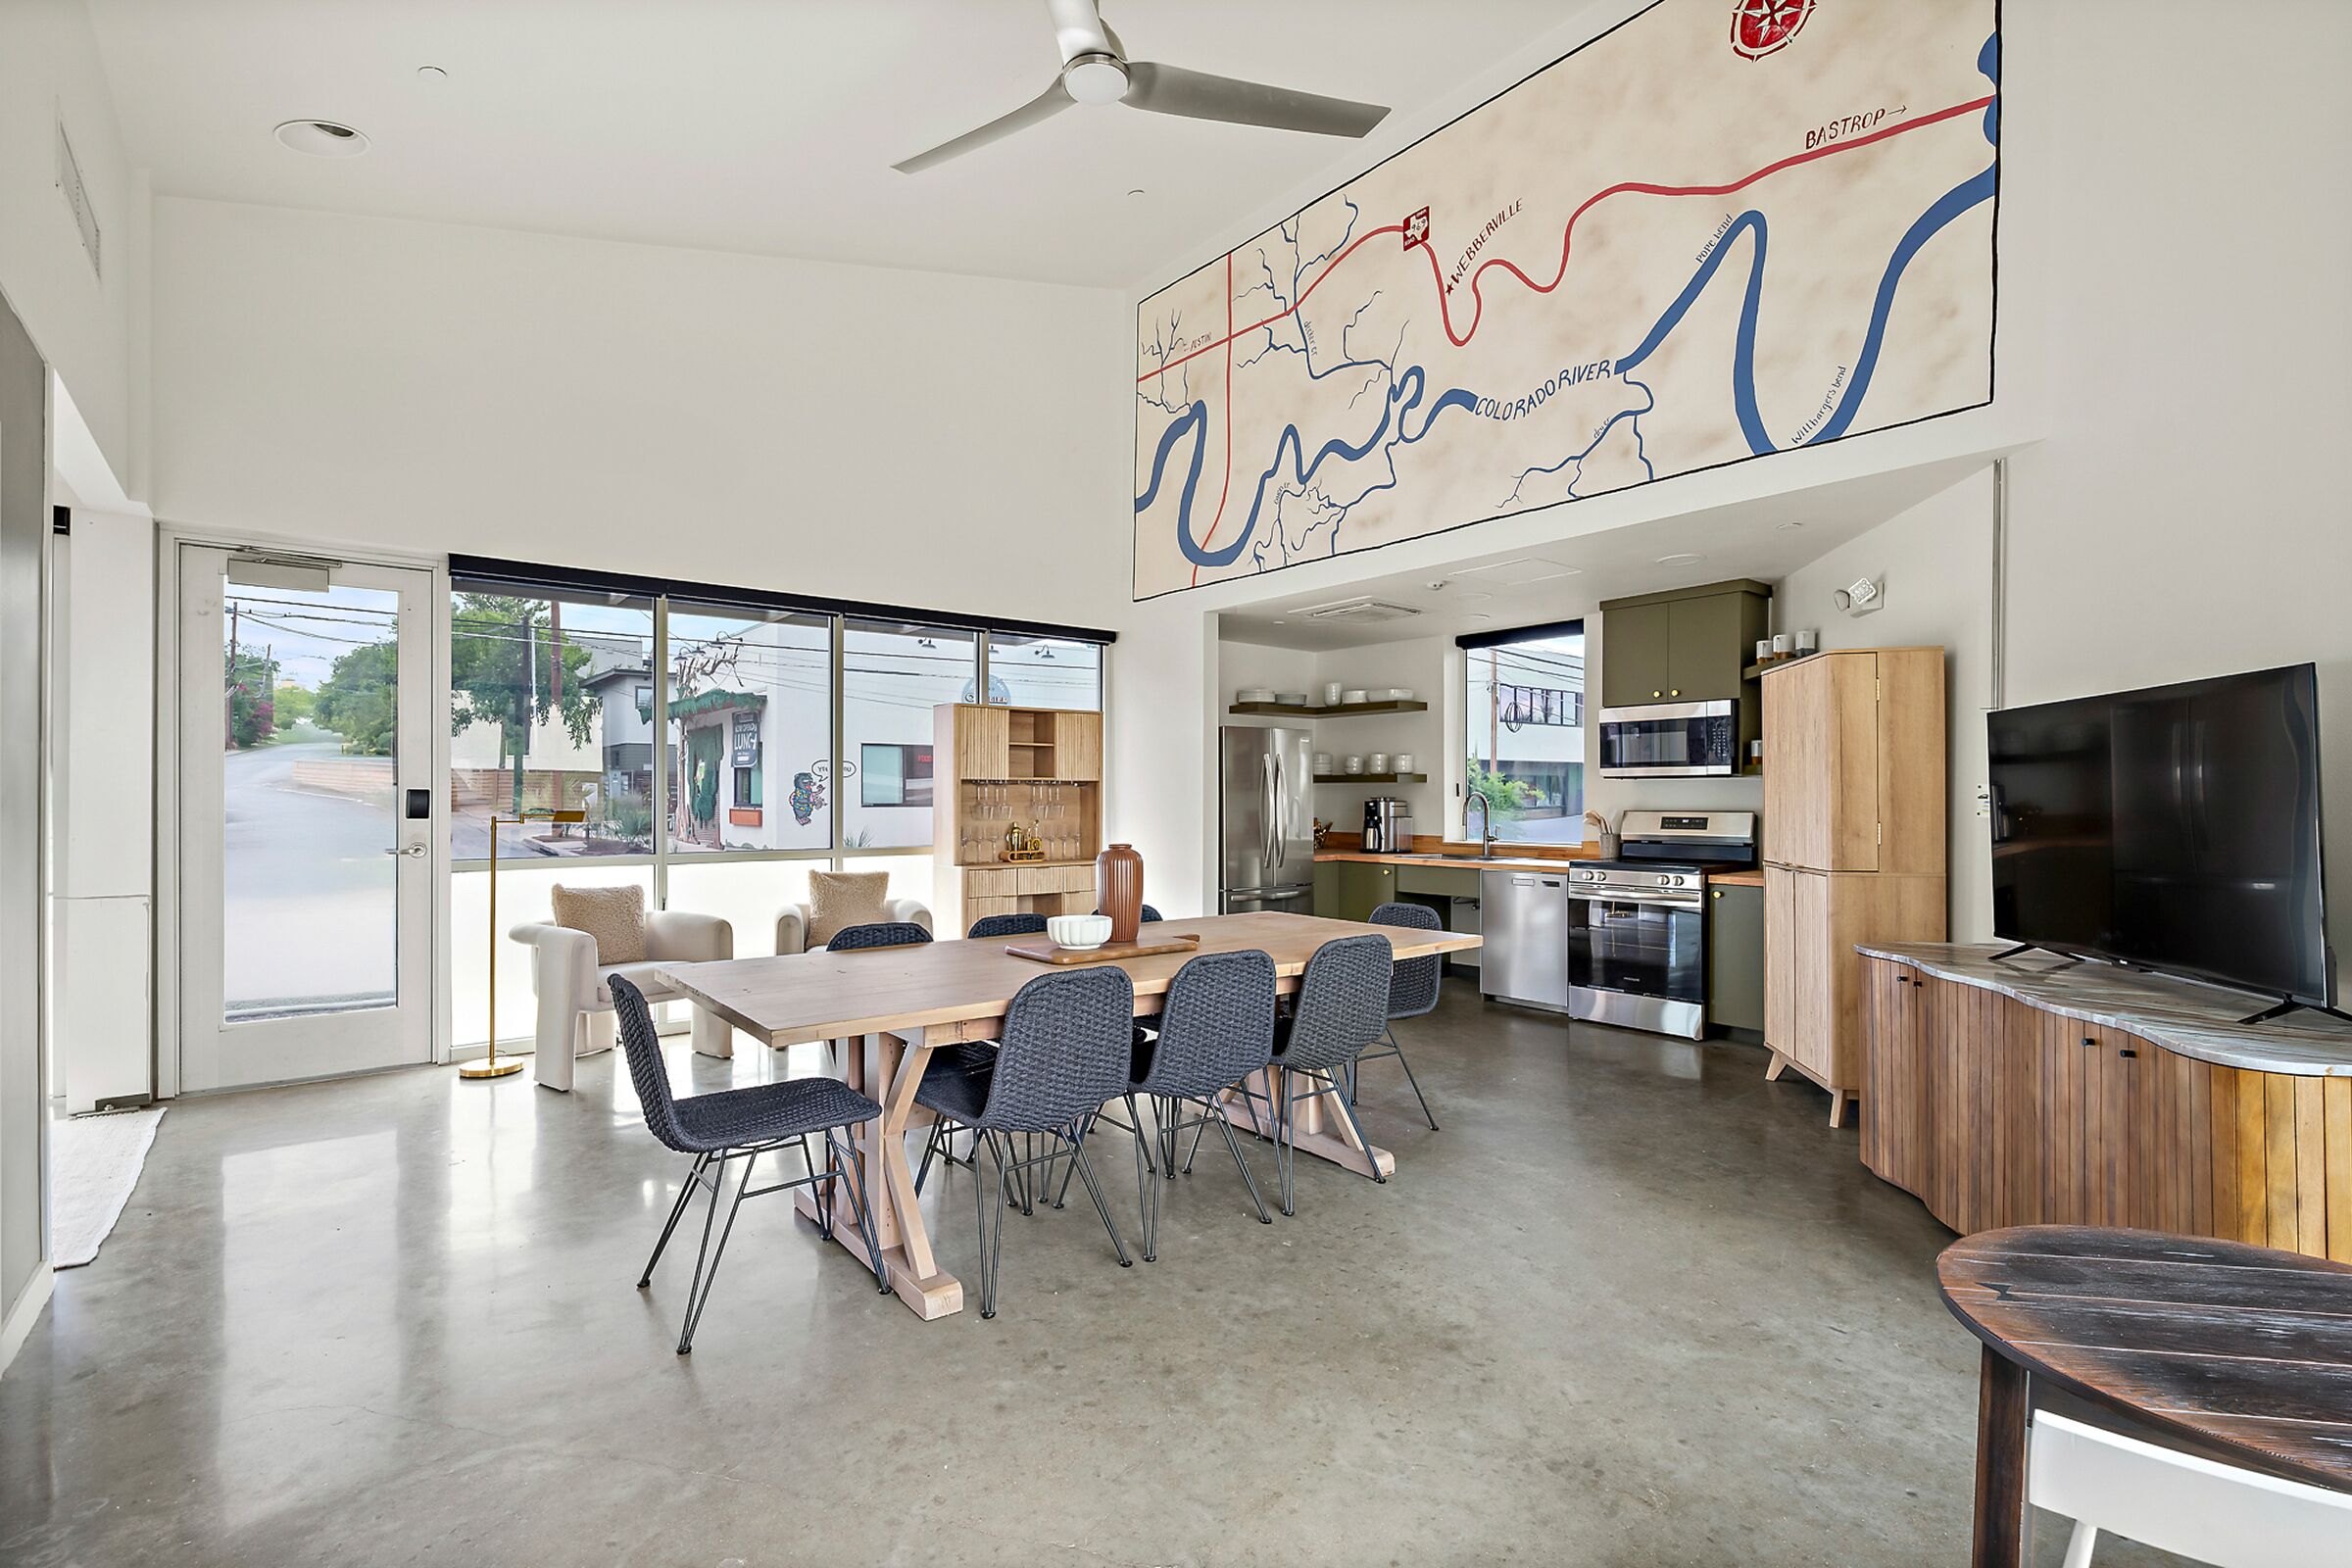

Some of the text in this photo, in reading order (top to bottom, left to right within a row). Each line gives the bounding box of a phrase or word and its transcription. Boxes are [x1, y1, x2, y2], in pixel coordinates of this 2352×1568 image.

[1805, 108, 1886, 150] BASTROP
[1411, 218, 1427, 233] 969
[1450, 197, 1523, 284] WEBBERVILLE
[1475, 359, 1611, 421] COLORADO RIVER
